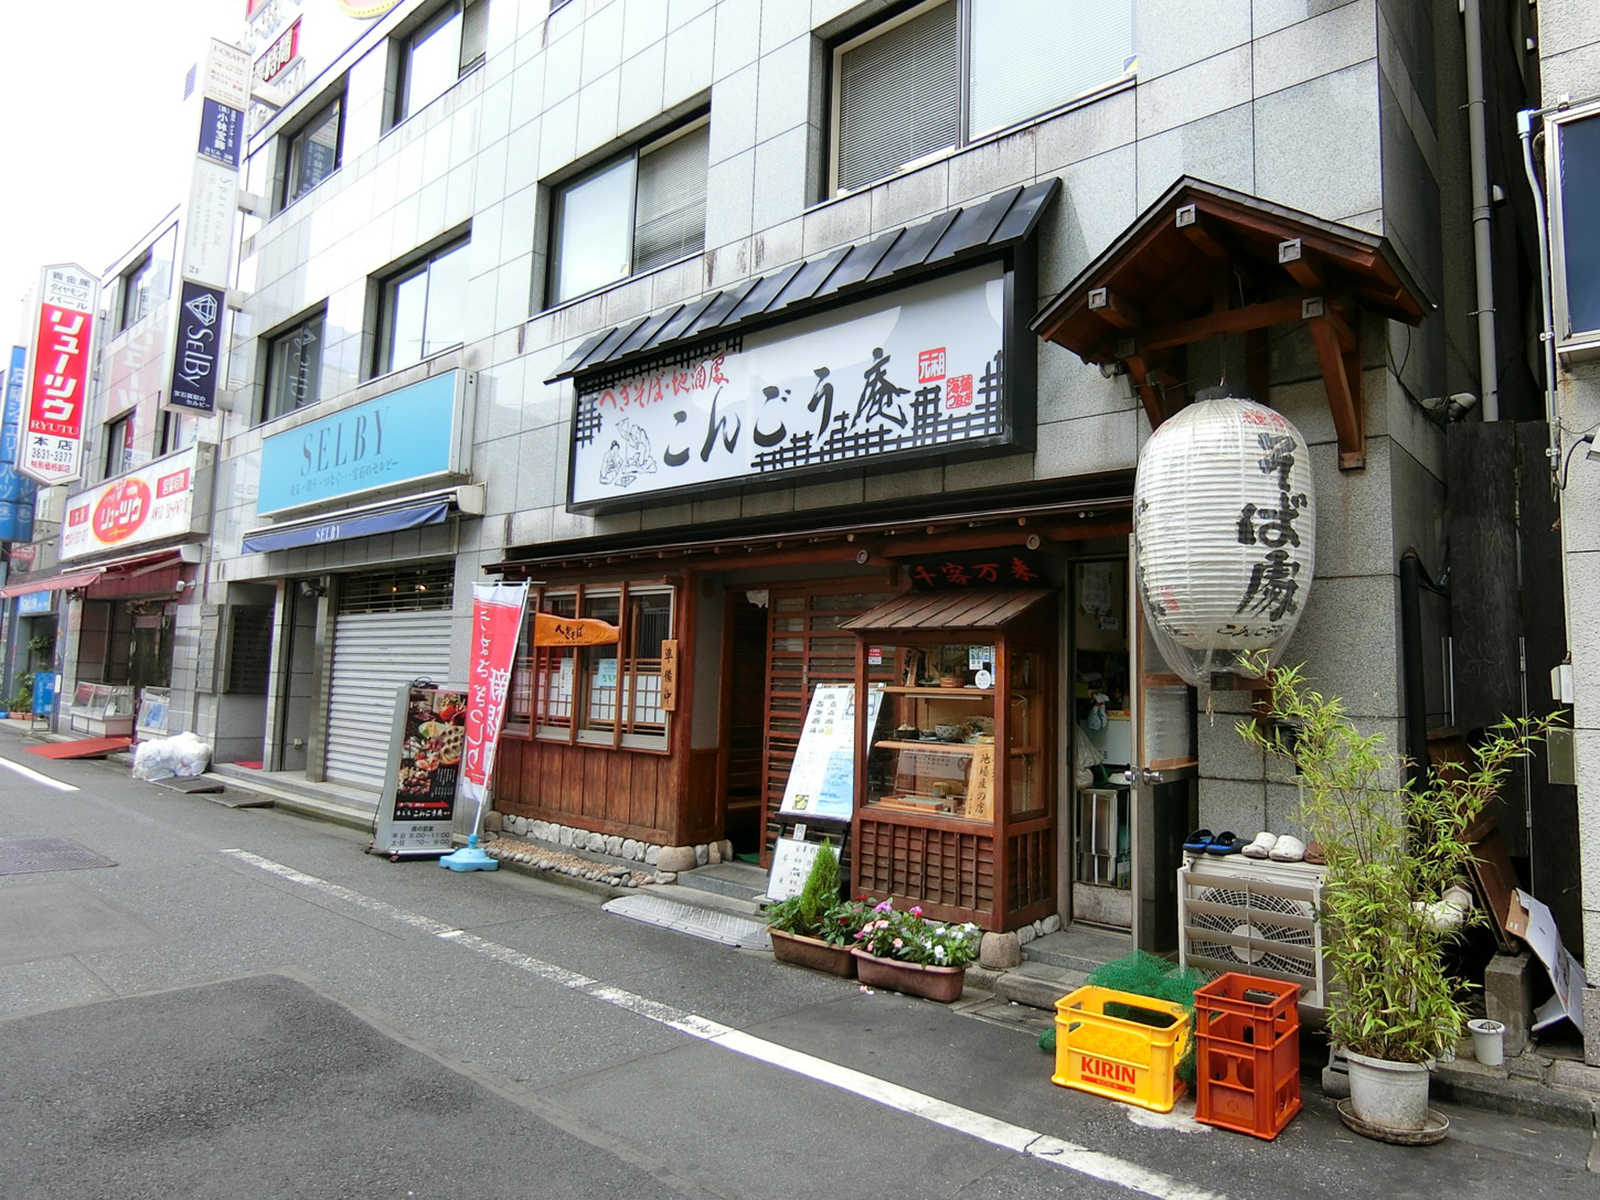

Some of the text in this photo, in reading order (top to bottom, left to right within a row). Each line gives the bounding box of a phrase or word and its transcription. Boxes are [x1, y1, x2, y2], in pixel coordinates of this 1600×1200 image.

[51, 283, 89, 299] ダイヤモンド
[42, 309, 85, 421] リューツウ
[663, 346, 911, 467] こんごう庵
[31, 419, 80, 436] RYUTU
[300, 406, 391, 477] SELBY
[33, 436, 74, 451] 本店
[100, 496, 144, 532] リューツウ
[315, 524, 340, 542] SELBY
[913, 556, 1040, 587] 千客万来
[663, 646, 674, 705] 準備中
[1081, 1056, 1136, 1085] KIRIN
